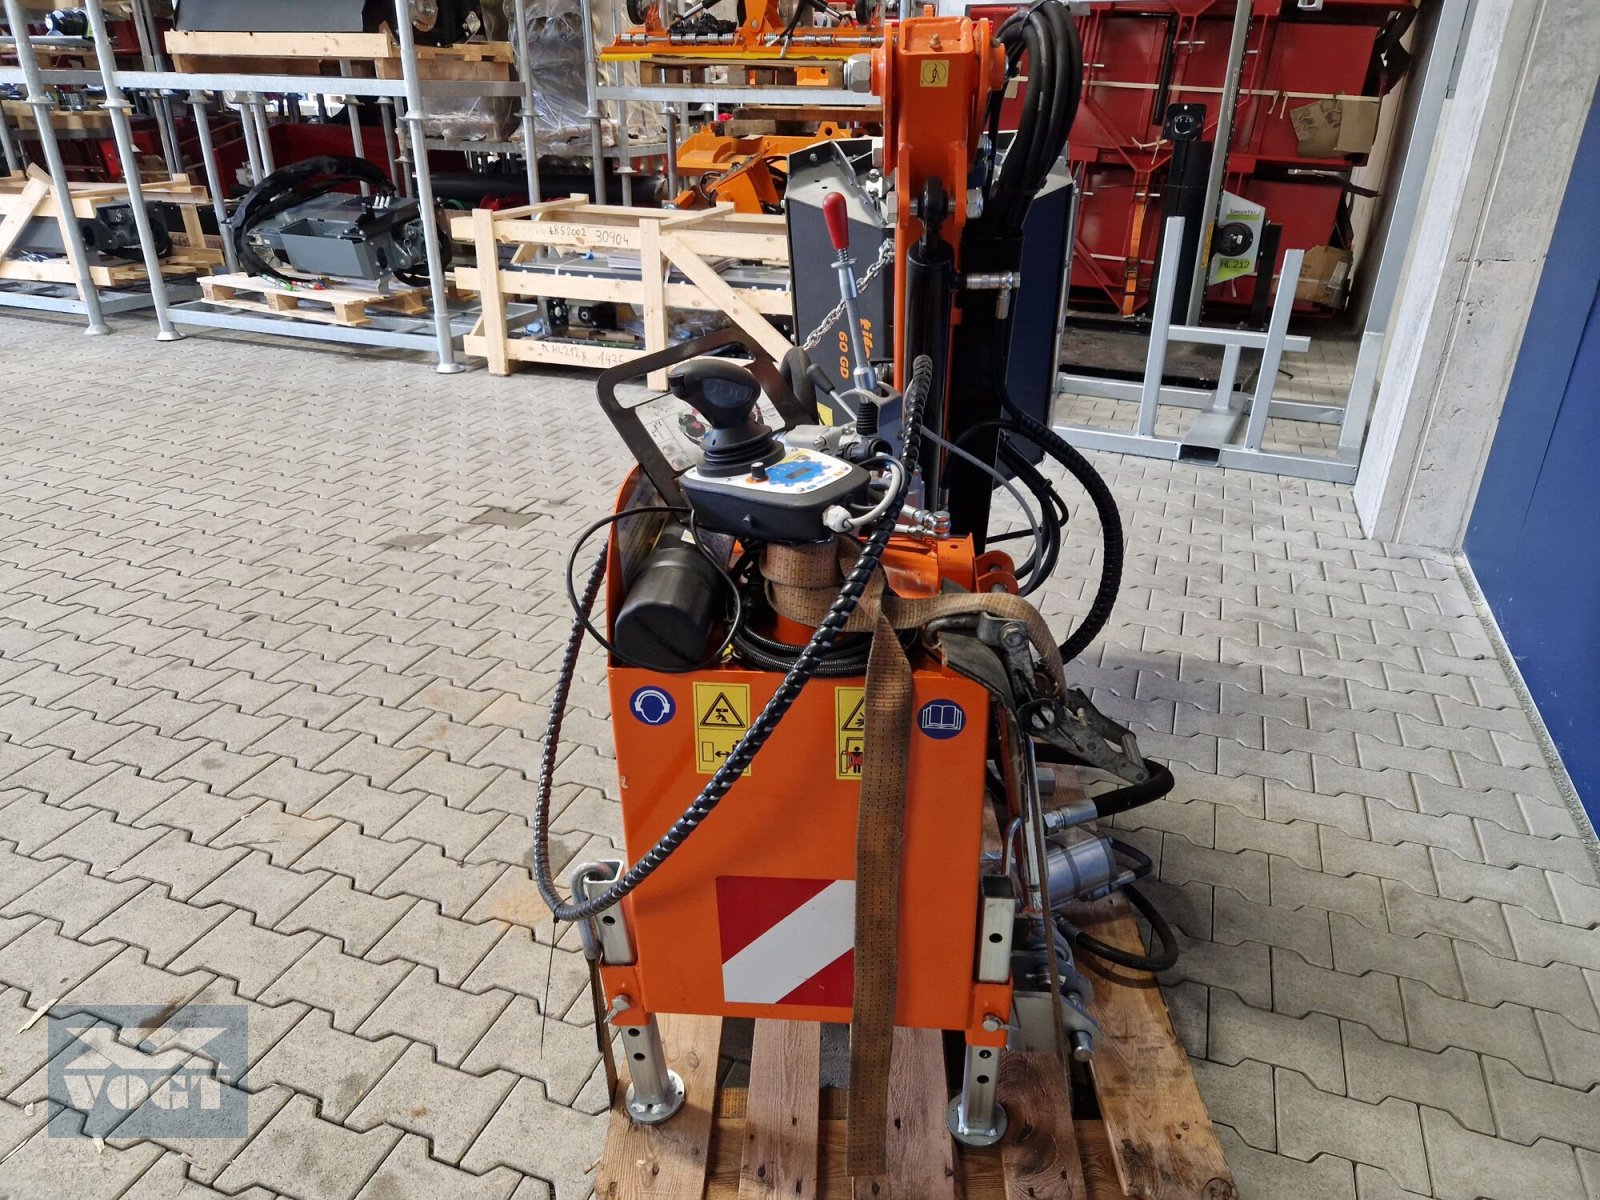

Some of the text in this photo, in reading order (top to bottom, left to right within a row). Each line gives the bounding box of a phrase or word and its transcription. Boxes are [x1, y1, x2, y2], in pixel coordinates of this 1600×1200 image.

[1232, 260, 1250, 269] 212
[838, 331, 849, 379] 60 GD
